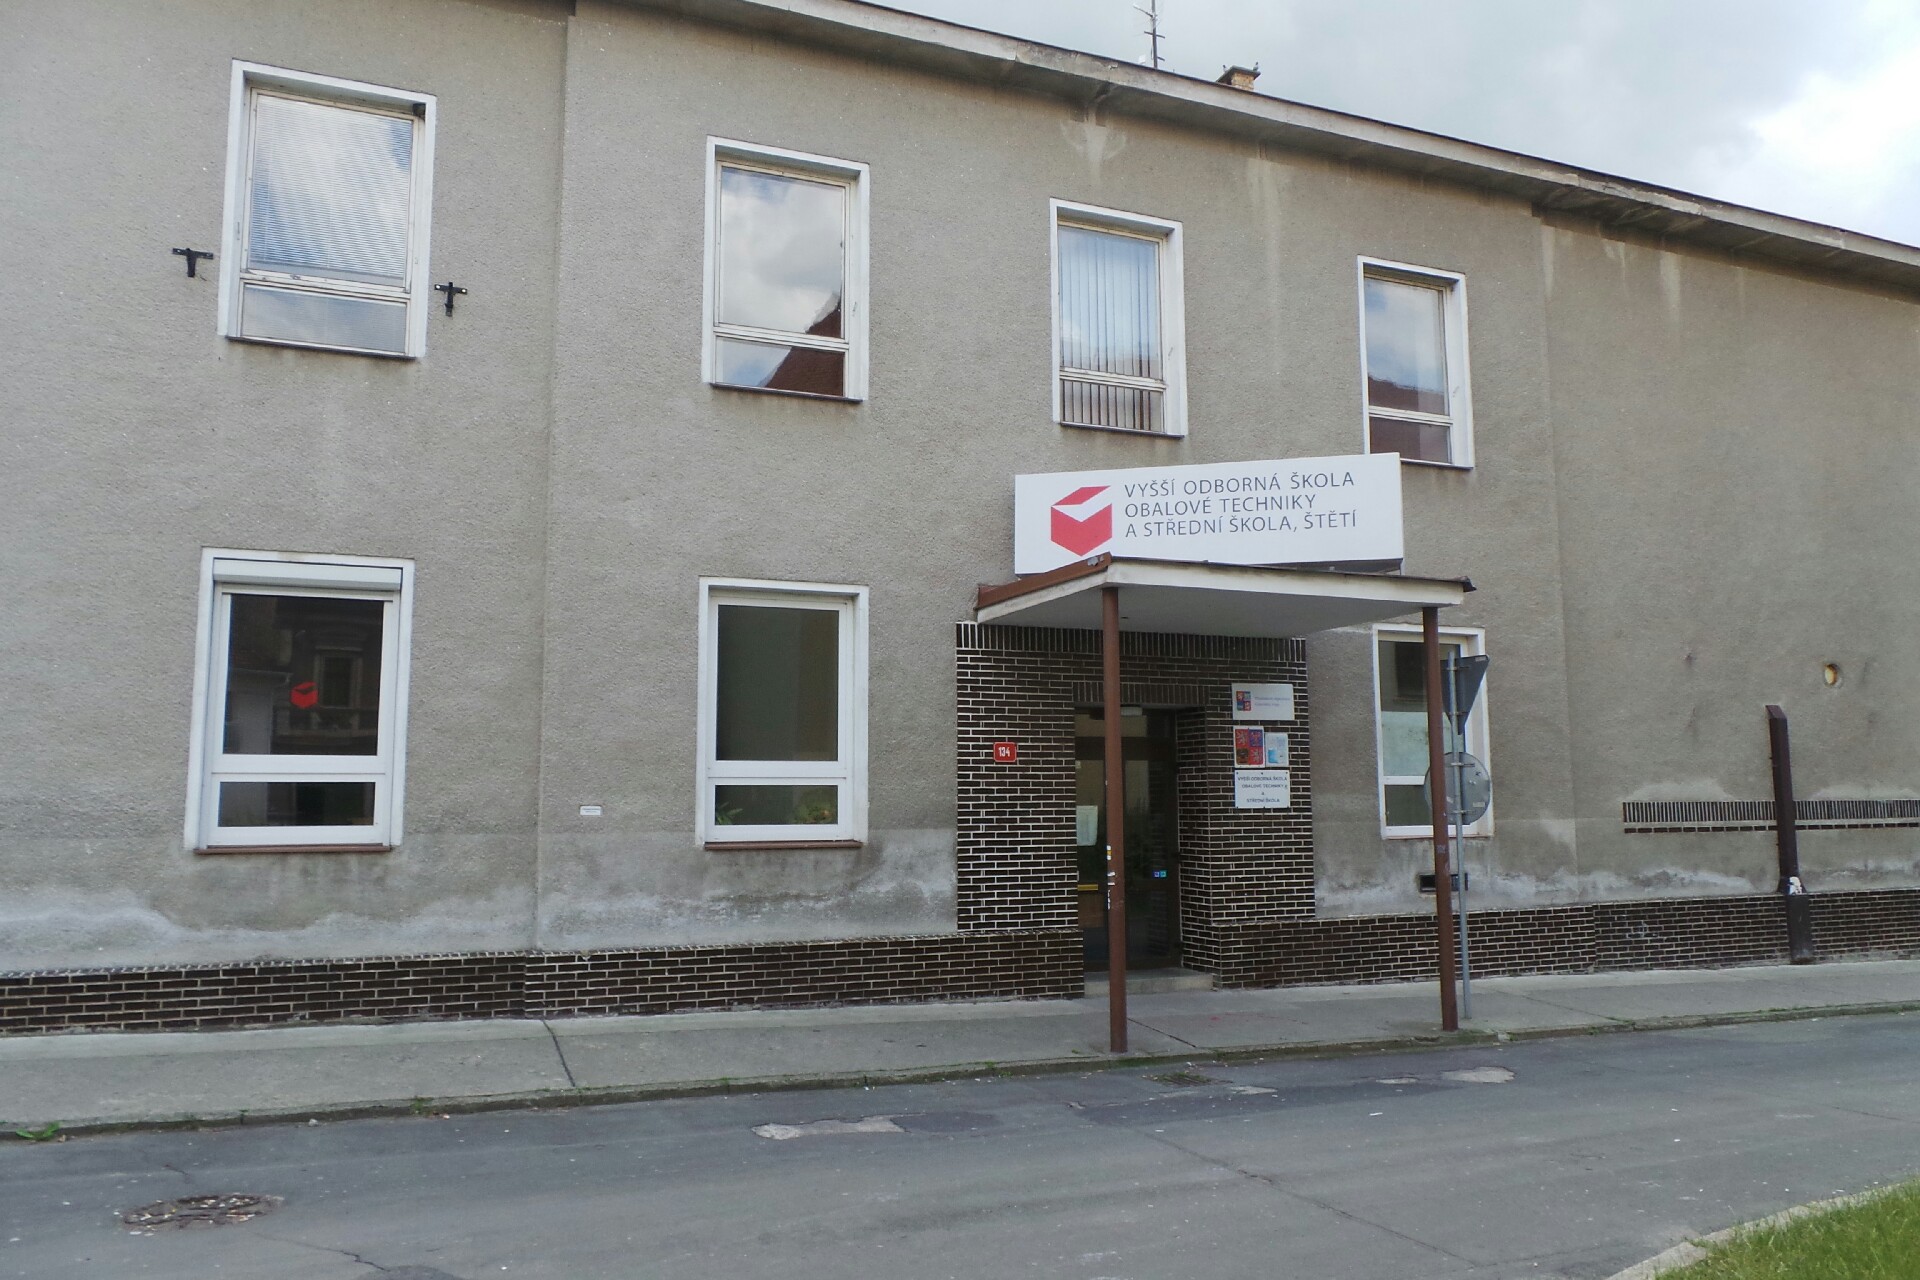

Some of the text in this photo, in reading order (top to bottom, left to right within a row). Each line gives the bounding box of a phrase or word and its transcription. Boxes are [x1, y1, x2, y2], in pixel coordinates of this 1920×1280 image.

[1125, 472, 1354, 497] VYŠŠÍ ODBORNÁ ŠKOLA
[1125, 494, 1316, 517] OBALOVÉ TECHNIKY
[1126, 509, 1357, 537] A STŘEDNÍ ŠKOLA, ŠTĚTÍ
[998, 747, 1010, 757] 134
